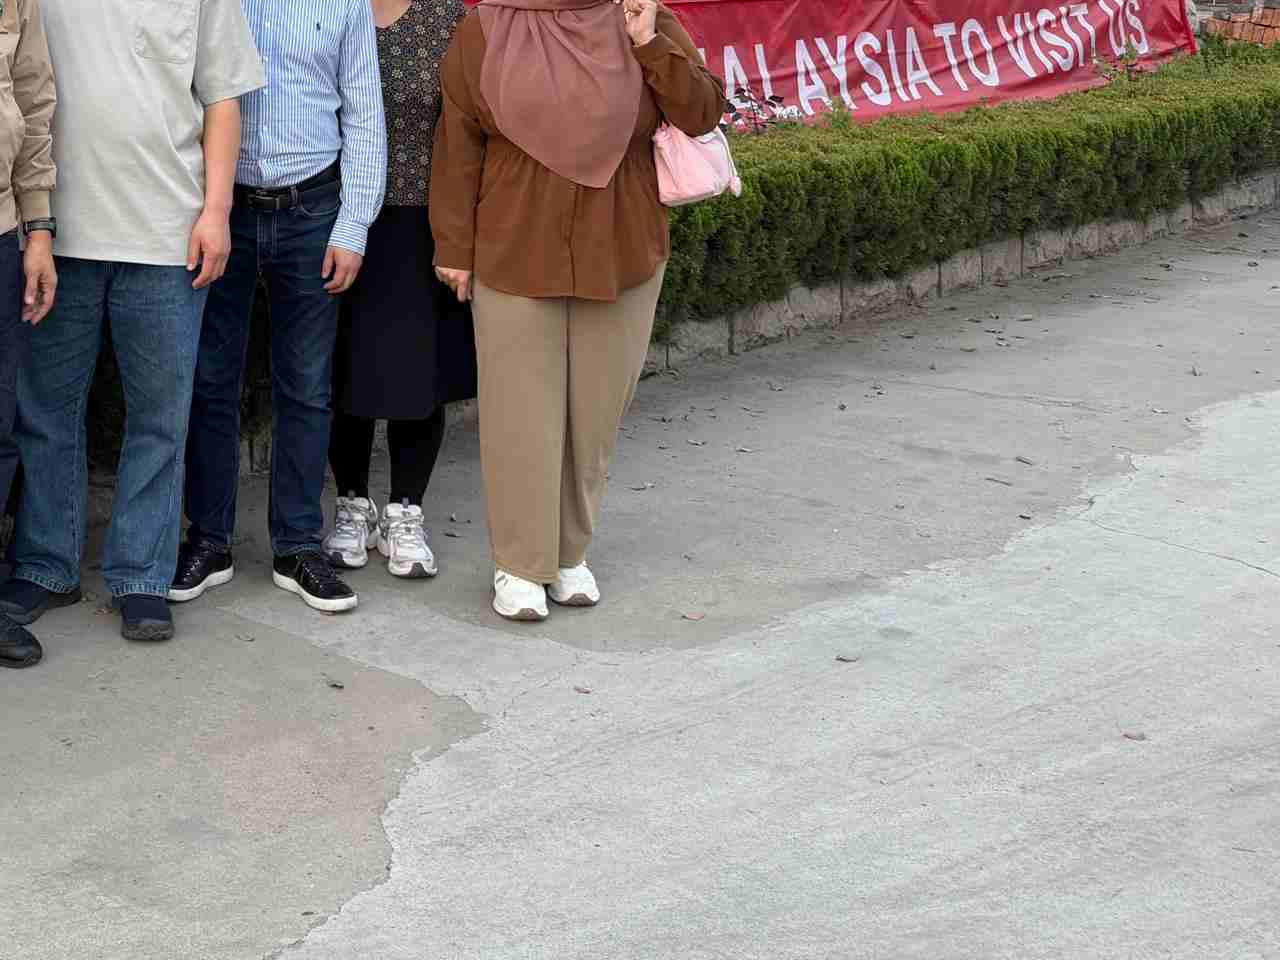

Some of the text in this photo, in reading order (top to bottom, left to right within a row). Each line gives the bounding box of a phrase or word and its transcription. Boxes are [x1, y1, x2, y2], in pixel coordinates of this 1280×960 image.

[696, 25, 944, 119] ALAYSIA
[933, 18, 1001, 92] TO
[996, 2, 1099, 79] VISIT
